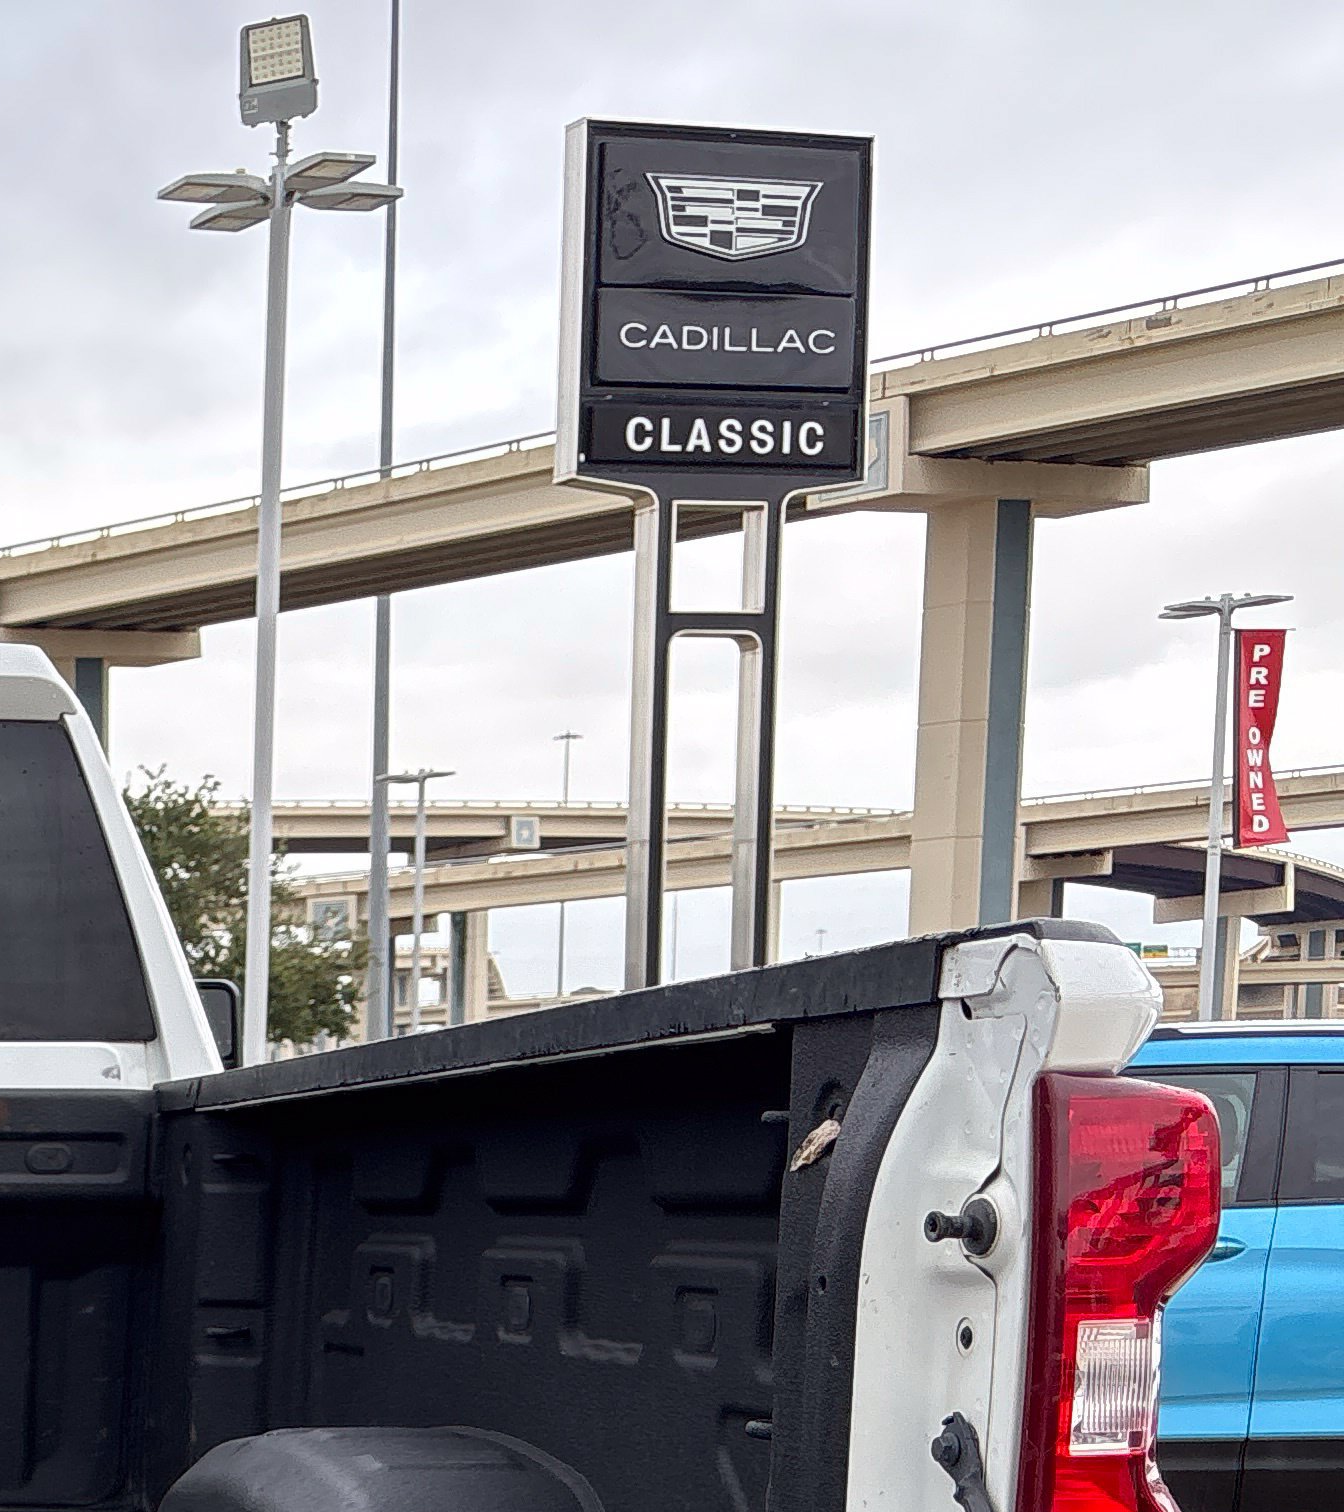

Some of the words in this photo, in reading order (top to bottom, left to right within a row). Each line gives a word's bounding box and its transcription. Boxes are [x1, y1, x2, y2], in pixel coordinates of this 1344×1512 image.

[619, 322, 836, 354] CADILLAC
[625, 416, 825, 456] CLASSIC
[1248, 644, 1271, 708] PRE
[1246, 726, 1271, 833] OWNED
